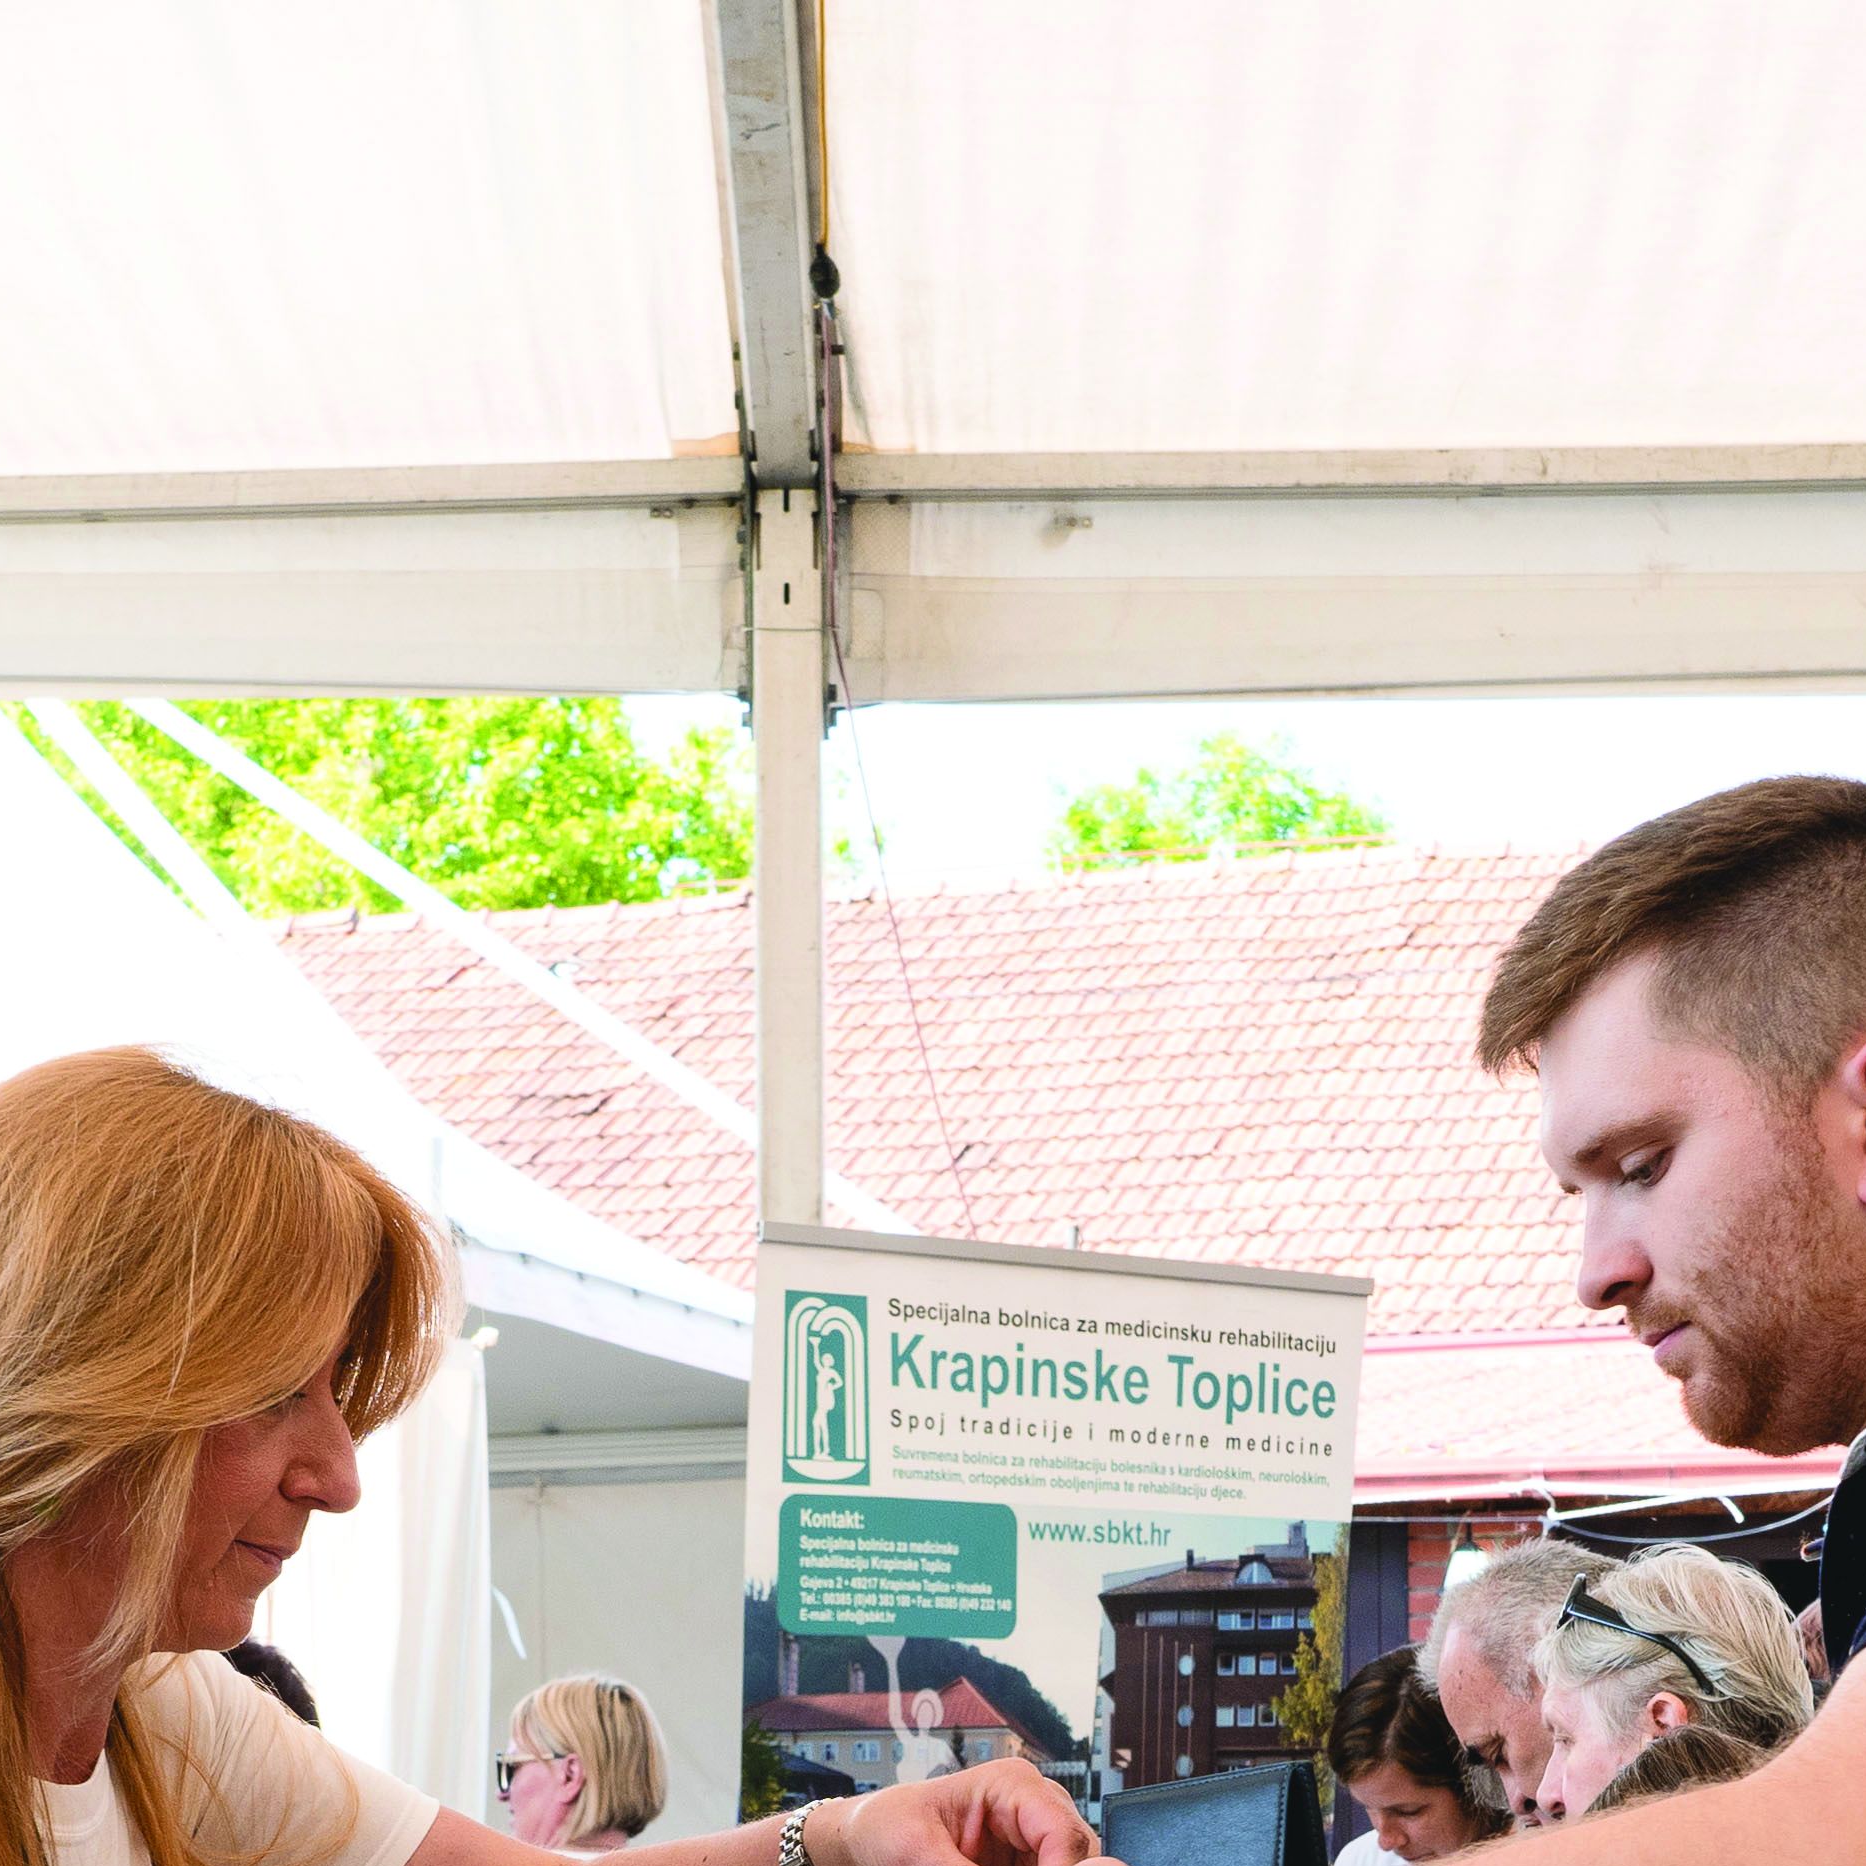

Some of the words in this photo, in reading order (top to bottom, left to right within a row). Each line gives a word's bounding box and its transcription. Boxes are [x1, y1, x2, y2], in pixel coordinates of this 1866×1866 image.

[888, 1297, 991, 1326] Specijalna
[998, 1307, 1070, 1332] bolnica
[1076, 1318, 1098, 1334] za
[1105, 1319, 1212, 1344] medicinsku
[1219, 1328, 1337, 1358] rehabilitaciju
[890, 1332, 1150, 1409] Krapinske
[1167, 1354, 1336, 1425] Toplice
[890, 1408, 946, 1437] Spoj
[959, 1415, 1074, 1443] tradicije
[1087, 1422, 1094, 1441] i
[1109, 1427, 1210, 1449] moderne
[1225, 1435, 1333, 1457] medicine
[892, 1445, 959, 1464] Suvremena
[962, 1450, 1008, 1467] bolnica
[1010, 1455, 1026, 1468] za
[1029, 1456, 1107, 1475] rehabilitaciju
[1110, 1460, 1167, 1475] bolesnika
[1178, 1464, 1256, 1482] kardiološkim,
[1258, 1470, 1331, 1488] neurološkim,
[892, 1467, 966, 1485] reumatskim,
[968, 1472, 1046, 1490] ortopedskim
[1050, 1477, 1120, 1494] oboljenjima
[1123, 1480, 1134, 1492] te
[1138, 1481, 1208, 1500] rehabilitaciju
[1210, 1485, 1247, 1501] djece.
[800, 1508, 865, 1530] Kontakt:
[1027, 1519, 1172, 1547] www.sbkt.hr
